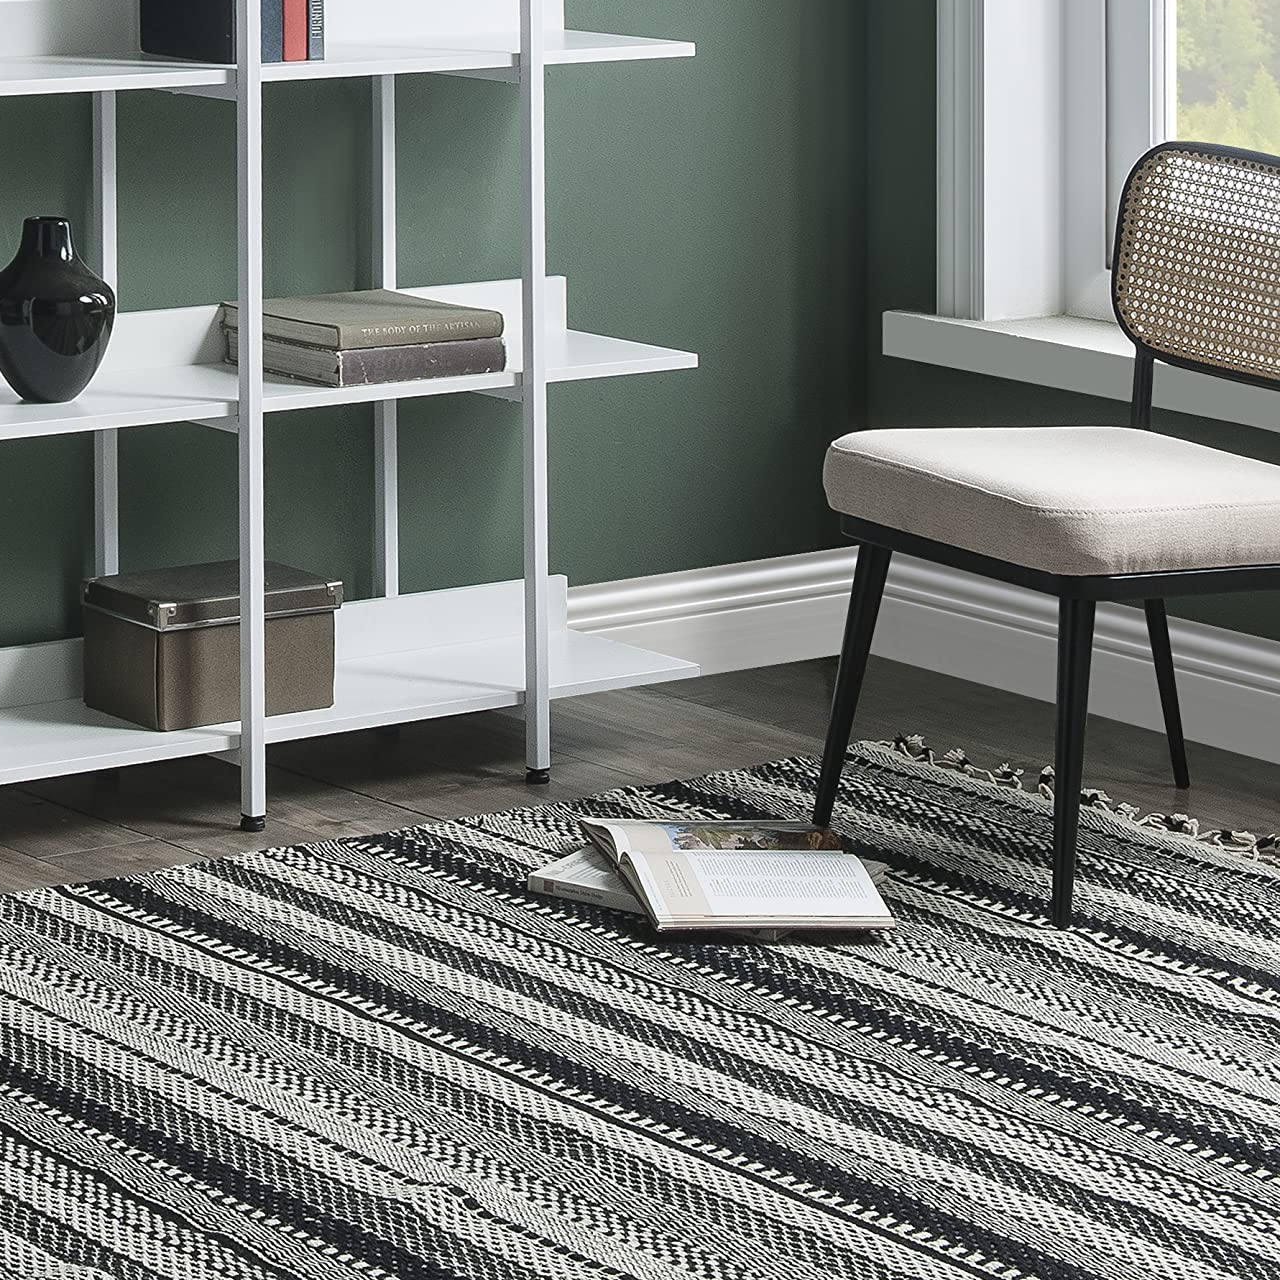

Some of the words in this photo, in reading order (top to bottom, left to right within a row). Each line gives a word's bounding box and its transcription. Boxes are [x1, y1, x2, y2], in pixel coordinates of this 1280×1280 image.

[361, 328, 380, 338] THE
[383, 326, 406, 336] BODY
[408, 324, 422, 334] OF
